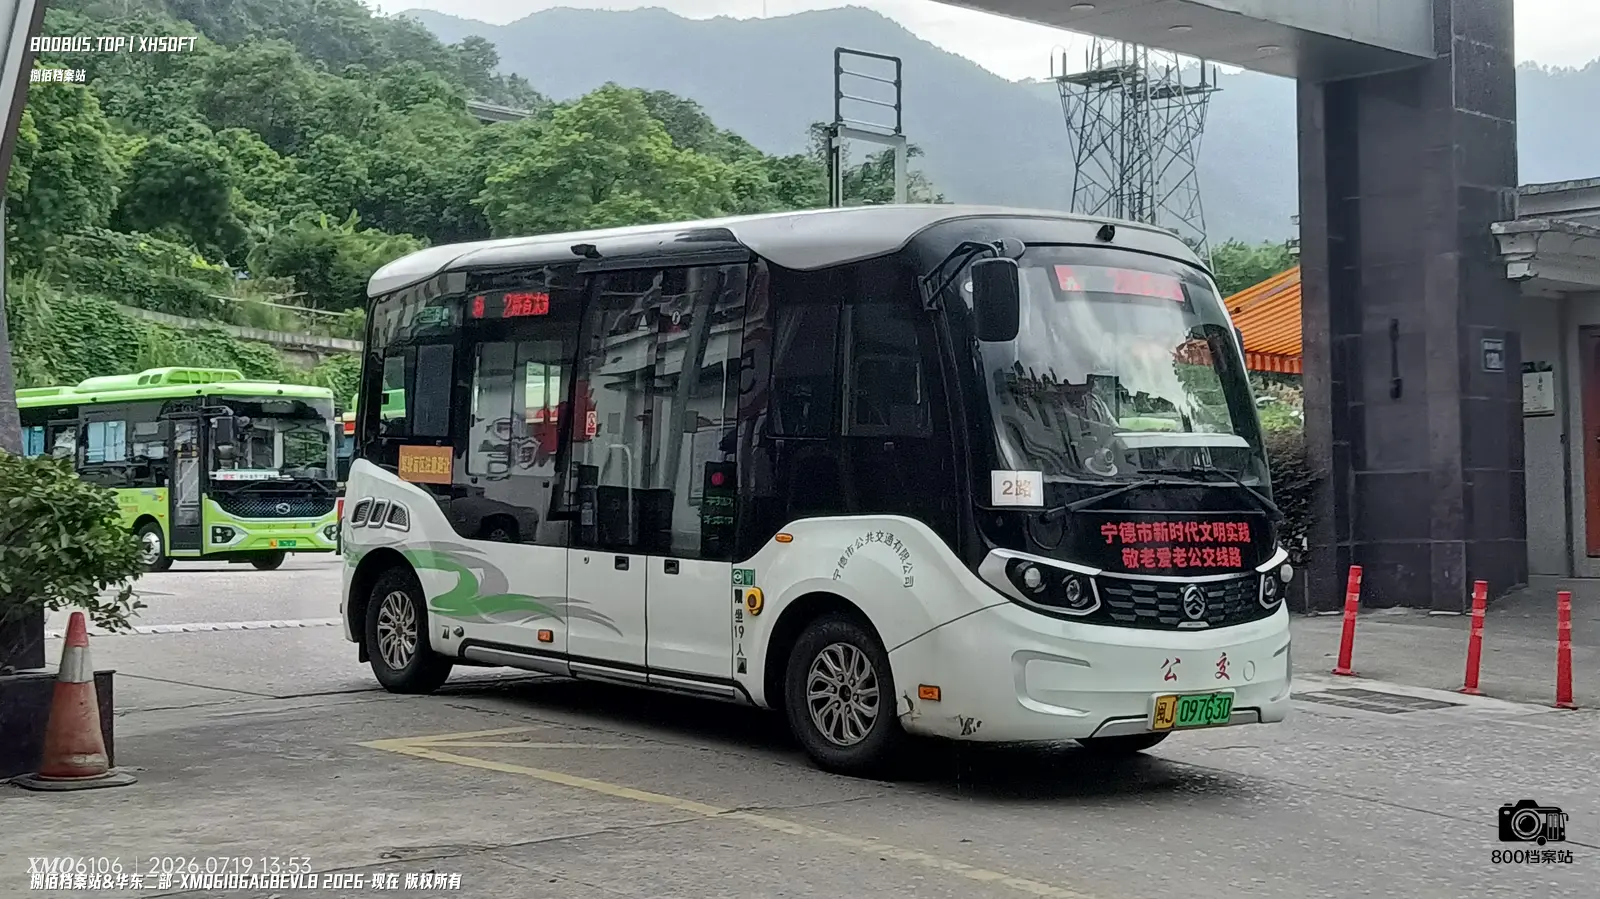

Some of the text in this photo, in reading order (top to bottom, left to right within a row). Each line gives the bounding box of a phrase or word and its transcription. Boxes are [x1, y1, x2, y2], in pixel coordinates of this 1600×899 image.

[1101, 521, 1251, 544] 宁德市新时代文明实践
[832, 530, 915, 588] 宁德市公共交通有限公司
[1121, 547, 1242, 568] 敬老爱老公交线路
